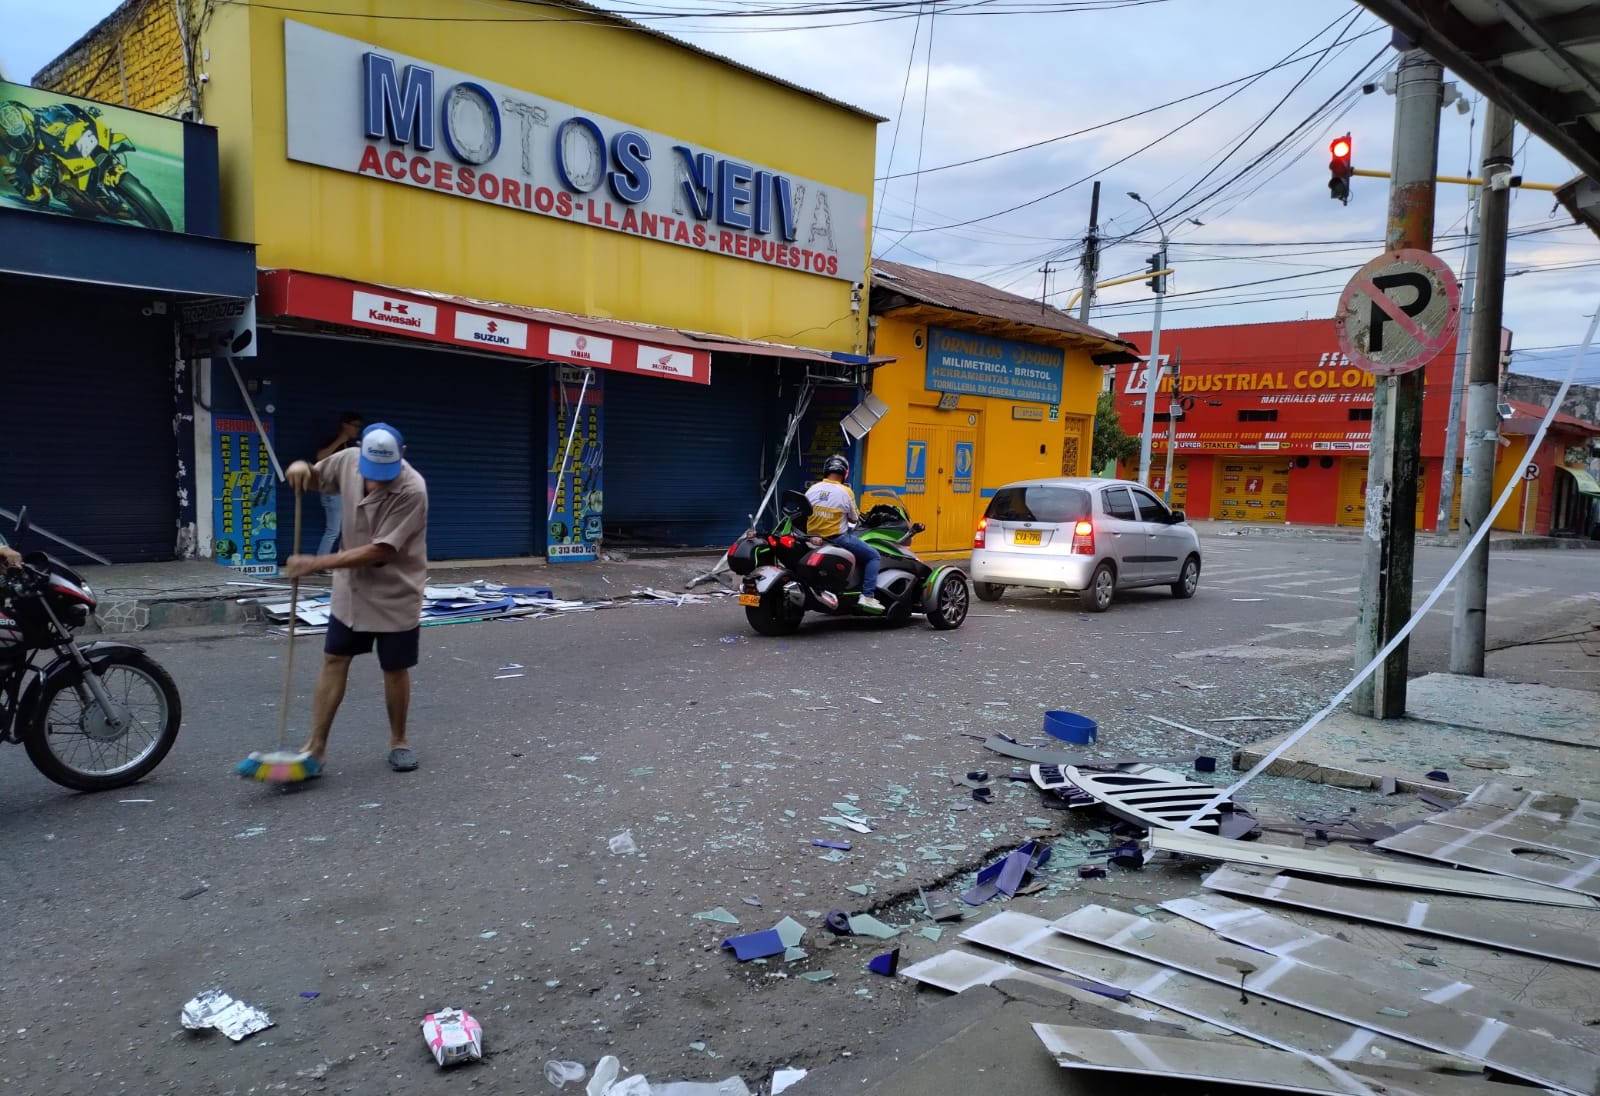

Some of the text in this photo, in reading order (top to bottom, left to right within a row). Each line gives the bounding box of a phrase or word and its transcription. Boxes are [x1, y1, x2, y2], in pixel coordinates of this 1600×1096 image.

[363, 52, 652, 204] MOTOS
[369, 309, 421, 328] Kawasaki
[1369, 272, 1431, 352] P
[473, 332, 509, 345] SUZUKI
[570, 350, 591, 360] YAMAHA
[652, 363, 678, 373] HONDA
[942, 356, 1007, 374] MILIMETRICA
[1014, 367, 1051, 381] BRISTOL
[932, 367, 1058, 391] HERRAMIENTAS MANUALES
[1294, 369, 1427, 389] COLOM
[1261, 394, 1316, 404] MATERIALES
[1318, 393, 1336, 403] QUE
[1339, 393, 1351, 402] TE
[0, 617, 17, 626] ero
